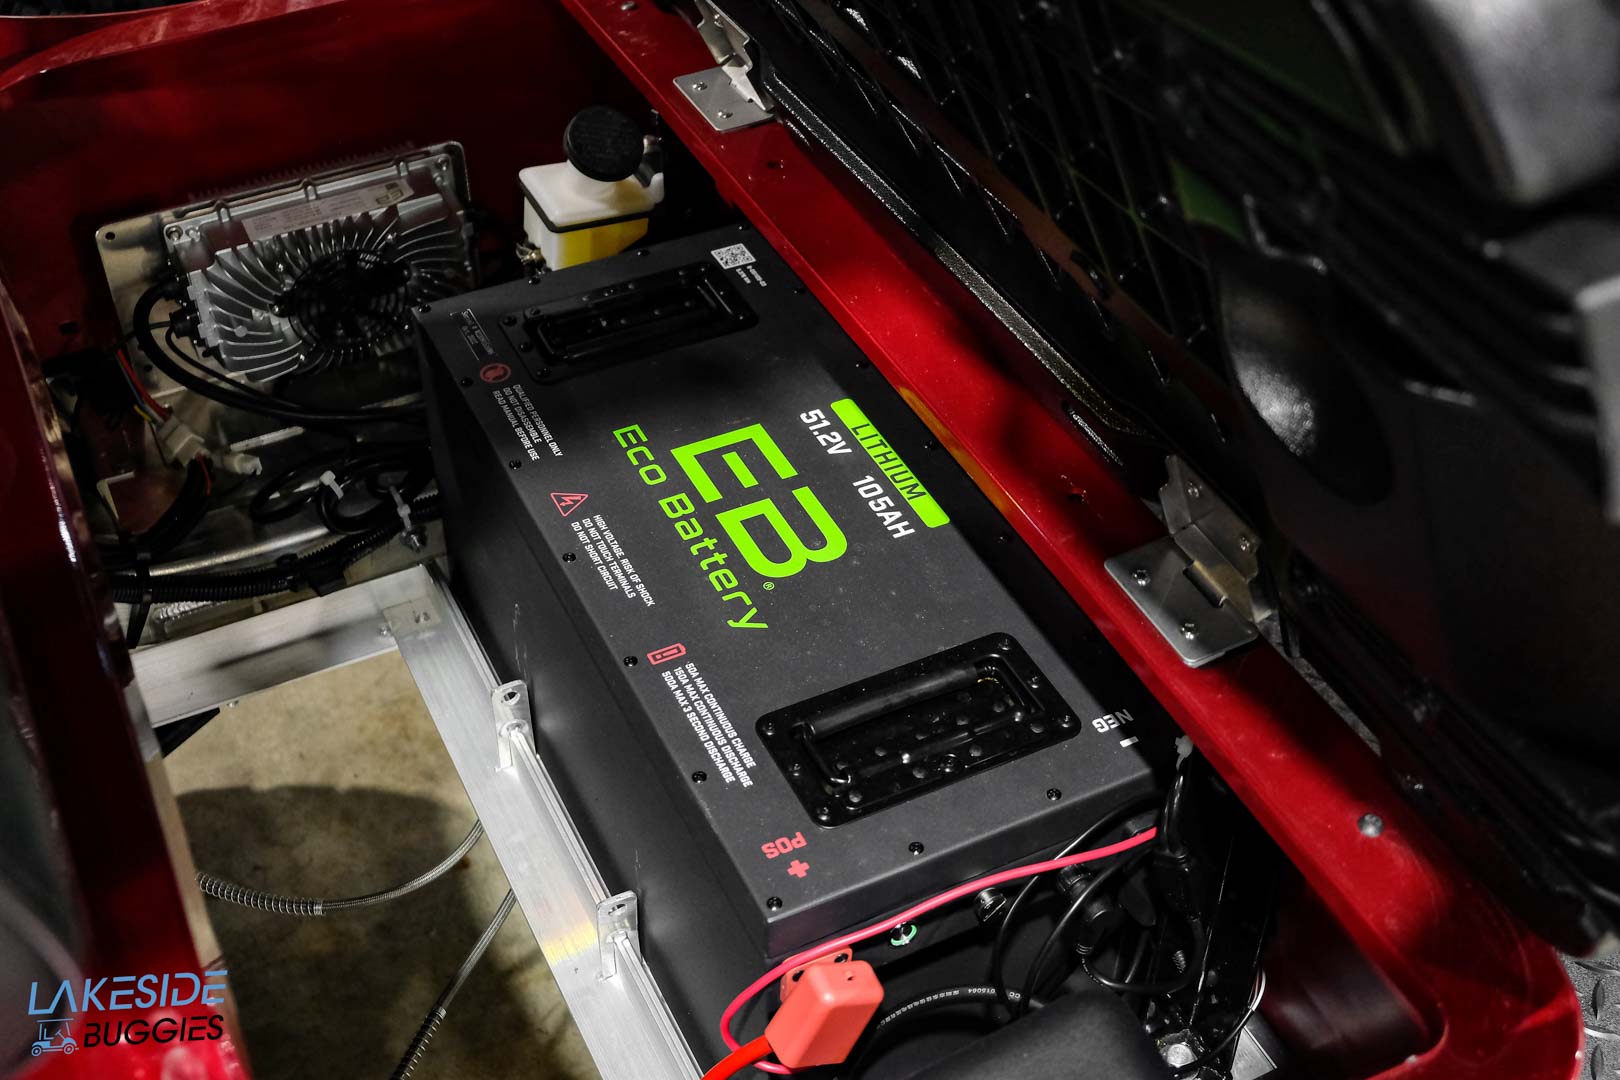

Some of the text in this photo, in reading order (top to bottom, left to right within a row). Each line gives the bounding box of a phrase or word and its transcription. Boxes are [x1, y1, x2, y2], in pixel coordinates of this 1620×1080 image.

[493, 390, 540, 461] READ MANUAL BEFORE USE
[503, 387, 542, 444] DO NOT DISASSEMBLE
[513, 384, 563, 457] QUALIFIED PERSONNEL ONLY
[799, 408, 852, 455] 51.2V
[850, 423, 926, 501] LITHIUM
[593, 514, 608, 531] HIGH
[670, 423, 848, 578] EB
[852, 475, 915, 539] 105AH
[571, 521, 619, 590] DO NOT SHORT CIRCUIT
[582, 518, 636, 599] DO NOT TOUCH TERMINALS
[620, 558, 636, 575] RISK
[630, 573, 641, 583] OF
[658, 492, 768, 629] Battery
[635, 583, 656, 607] SHOCK
[661, 670, 678, 691] 500A
[673, 689, 689, 707] MAX
[686, 711, 710, 741] SECOND
[703, 740, 736, 783] DISCHARGE
[673, 666, 753, 788] 150A MAX CONTINUOUS DISCHARGE
[685, 662, 756, 769] 50A MAX CONTINUOUS CHARGE
[1091, 708, 1134, 733] NEG
[761, 831, 807, 859] POS
